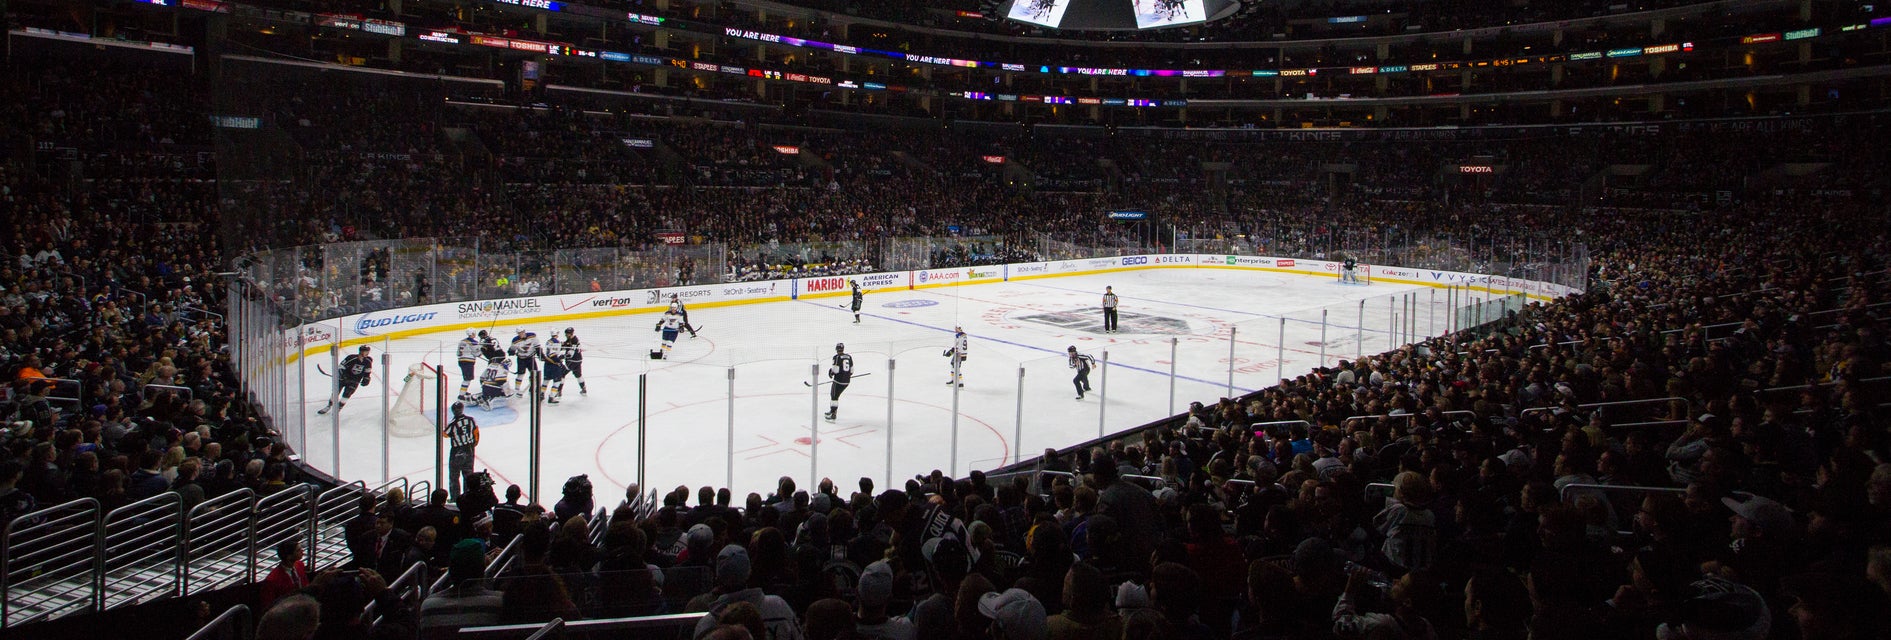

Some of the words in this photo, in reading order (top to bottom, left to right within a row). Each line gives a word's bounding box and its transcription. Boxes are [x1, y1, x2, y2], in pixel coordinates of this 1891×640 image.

[522, 0, 551, 9] HERE
[725, 28, 742, 36] YOU
[743, 29, 759, 40] ARE
[760, 33, 780, 43] HERE
[511, 41, 546, 52] TOSHIBA
[1644, 43, 1680, 54] TOSHIBA
[638, 56, 662, 65] DELTA
[906, 53, 919, 62] YOU
[919, 55, 933, 64] ARE
[933, 57, 951, 65] HERE
[693, 62, 718, 72] STAPLES
[1093, 67, 1107, 75] ARE
[1384, 65, 1408, 73] DELTA
[1411, 63, 1437, 71] STAPLES
[809, 75, 831, 84] TOYOTA
[1122, 256, 1147, 265] GEICO
[929, 271, 960, 281] AAA.com
[807, 277, 845, 292] HARIBO
[862, 279, 893, 287] EXPRESS
[679, 289, 711, 298] RESORTS
[747, 286, 767, 295] Seating
[458, 302, 483, 314] SAN
[493, 298, 541, 311] MANUEL
[592, 297, 631, 308] verizon
[360, 319, 391, 330] BUD
[392, 312, 438, 325] LIGHT
[842, 359, 850, 372] 6
[485, 368, 498, 381] 30
